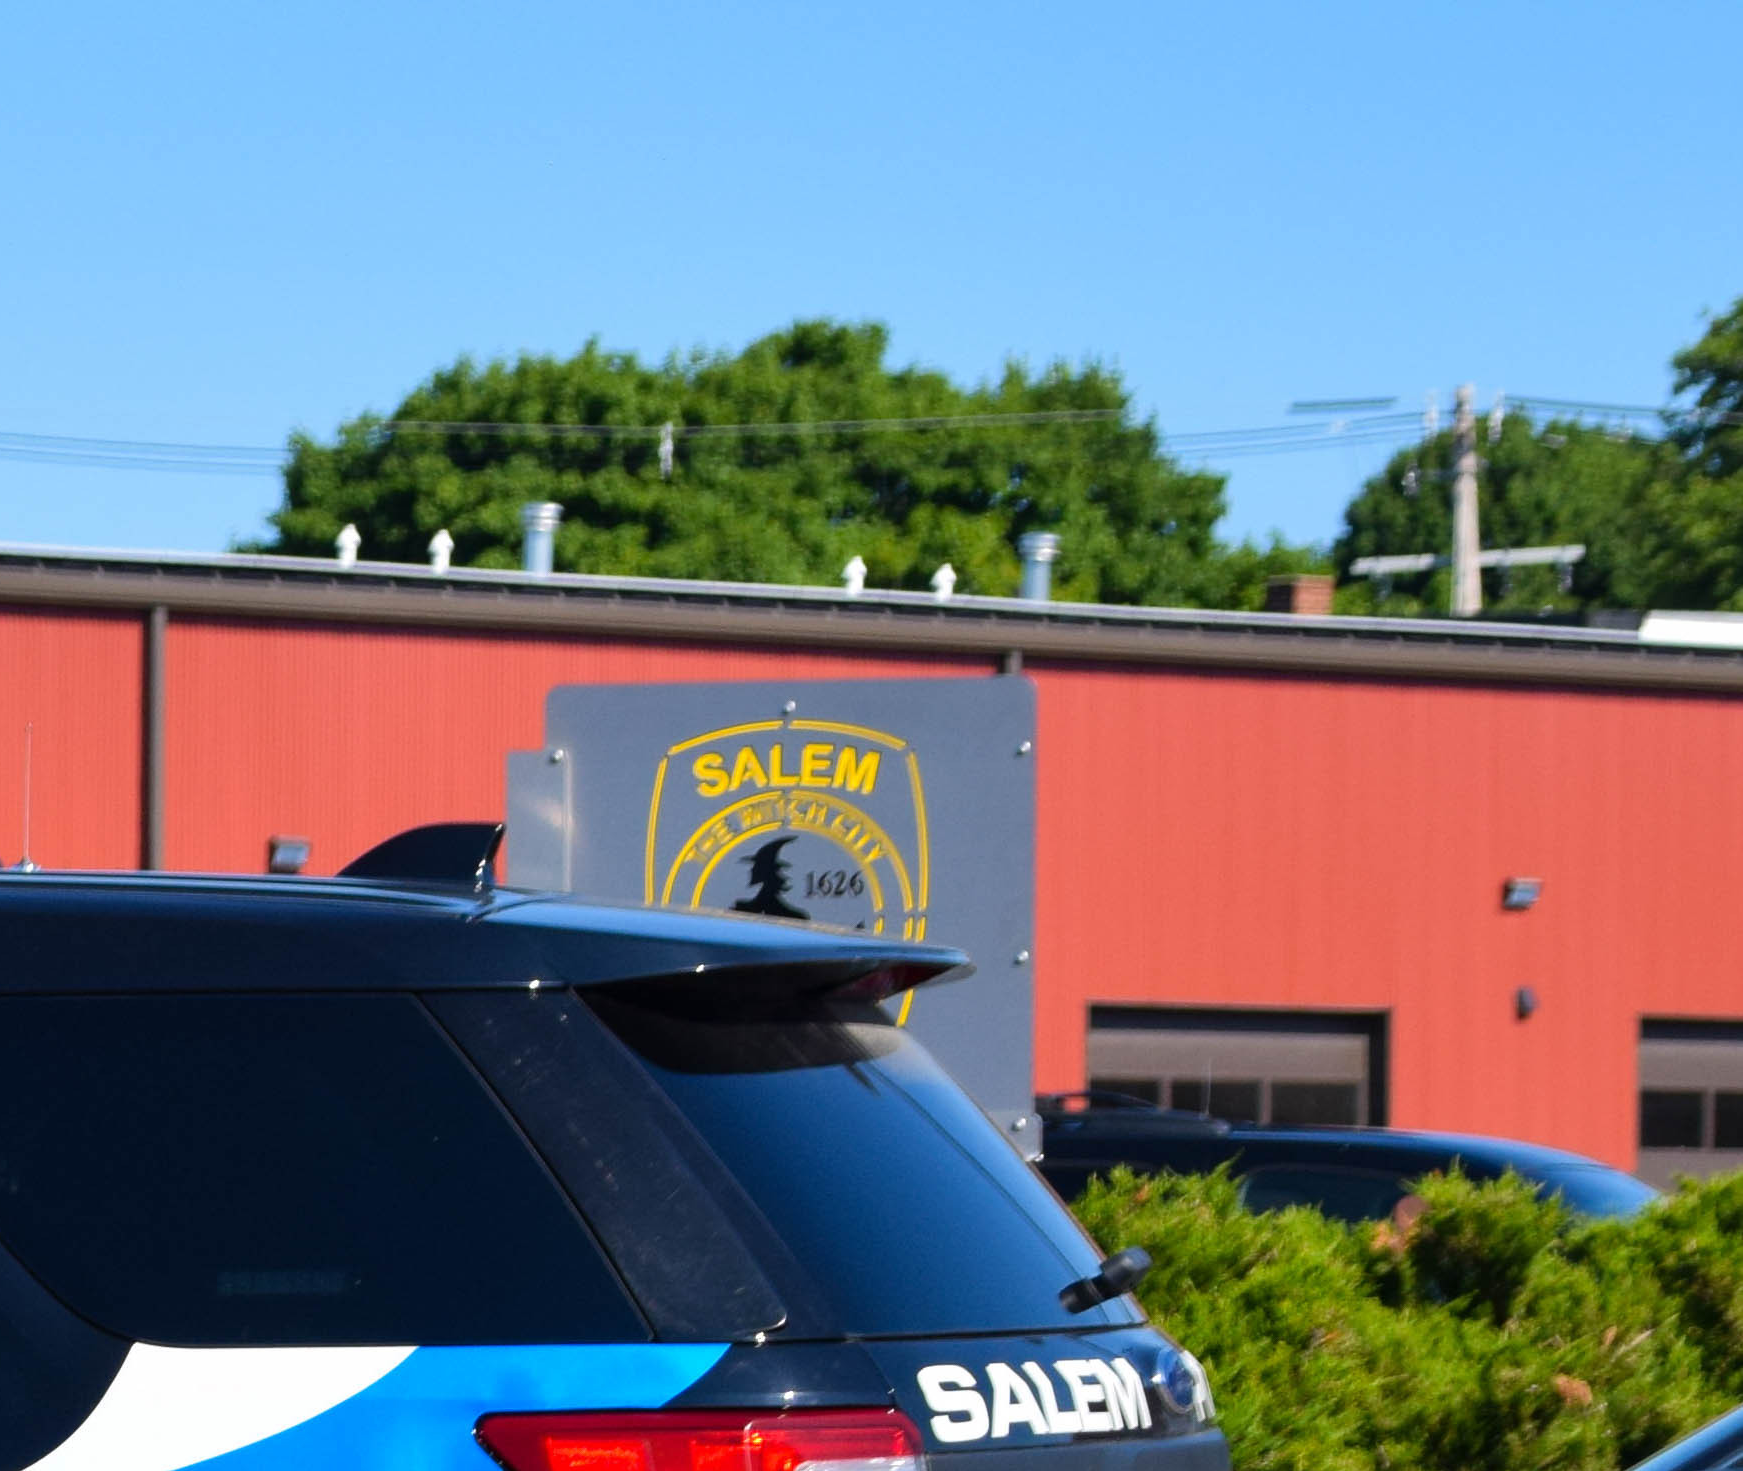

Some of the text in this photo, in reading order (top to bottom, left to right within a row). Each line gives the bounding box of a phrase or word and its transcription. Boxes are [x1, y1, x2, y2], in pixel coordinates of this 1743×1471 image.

[693, 744, 881, 797] SALEM
[805, 868, 865, 899] 1626
[917, 1357, 1152, 1443] SALEM
